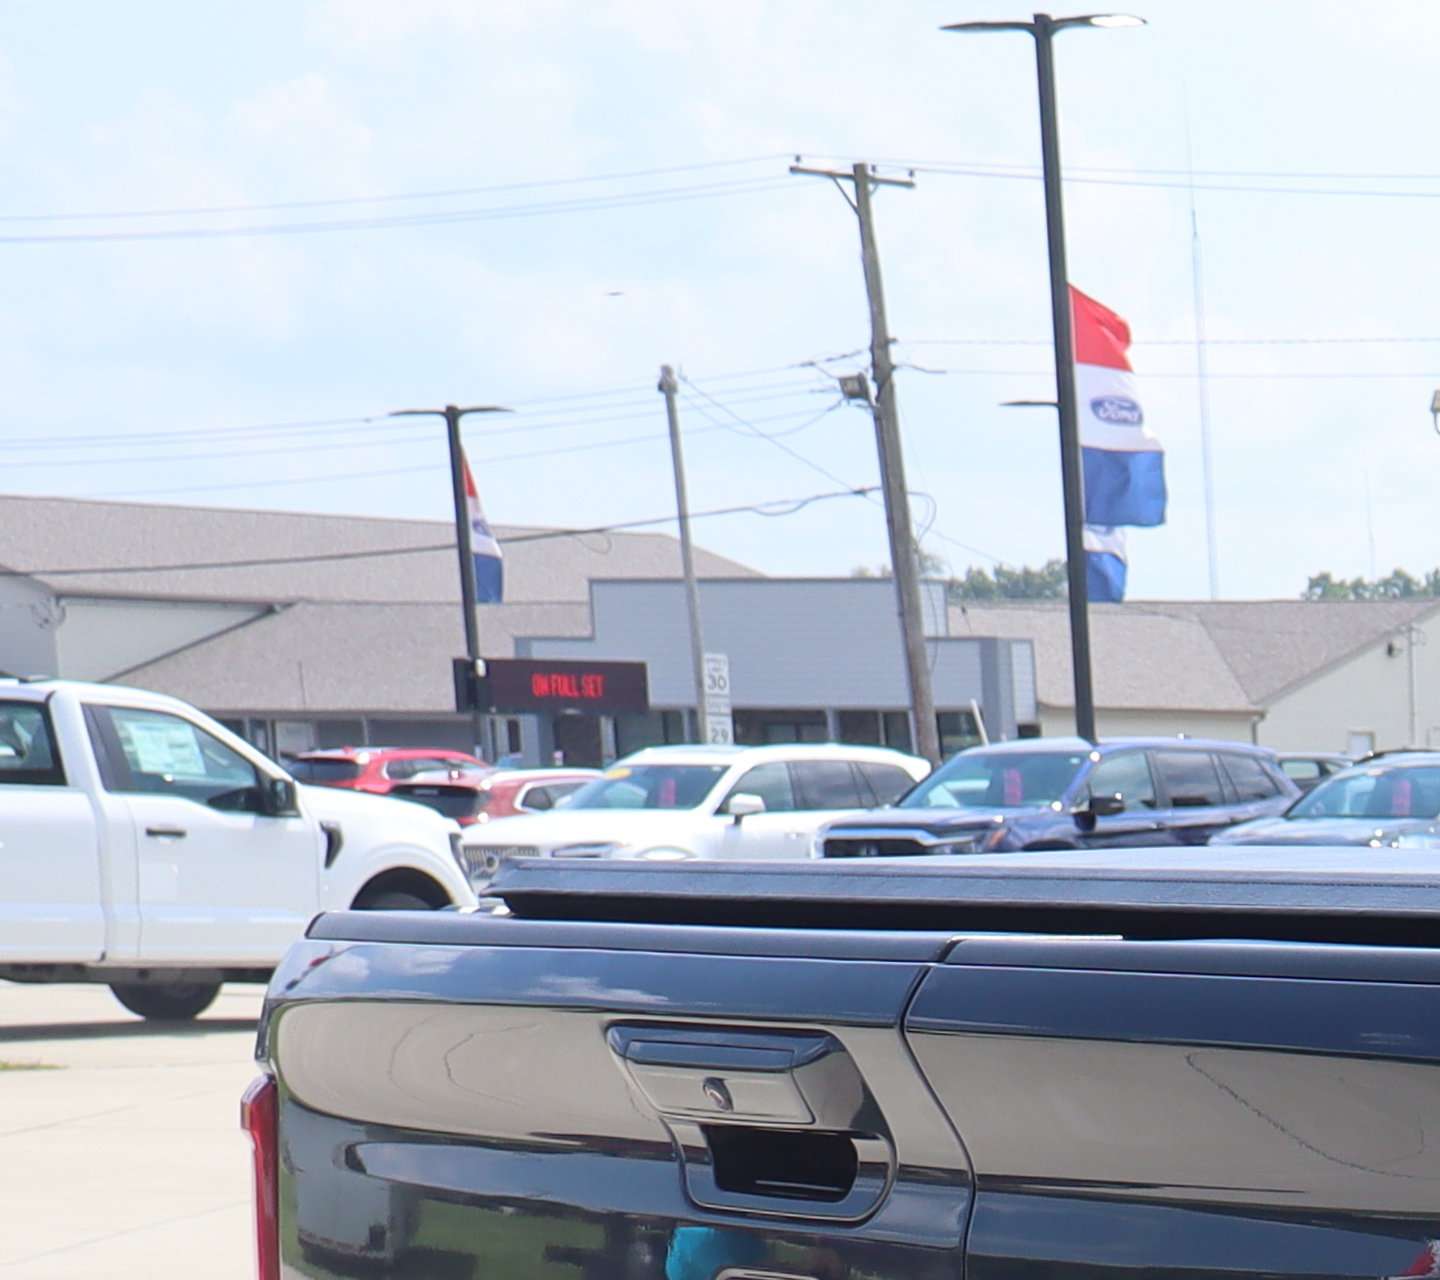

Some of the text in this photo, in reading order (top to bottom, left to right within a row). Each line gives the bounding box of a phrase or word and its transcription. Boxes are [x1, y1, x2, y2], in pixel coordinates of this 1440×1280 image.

[551, 673, 580, 698] FULL
[581, 674, 605, 698] SET
[707, 672, 727, 691] 30
[710, 726, 729, 744] 29
